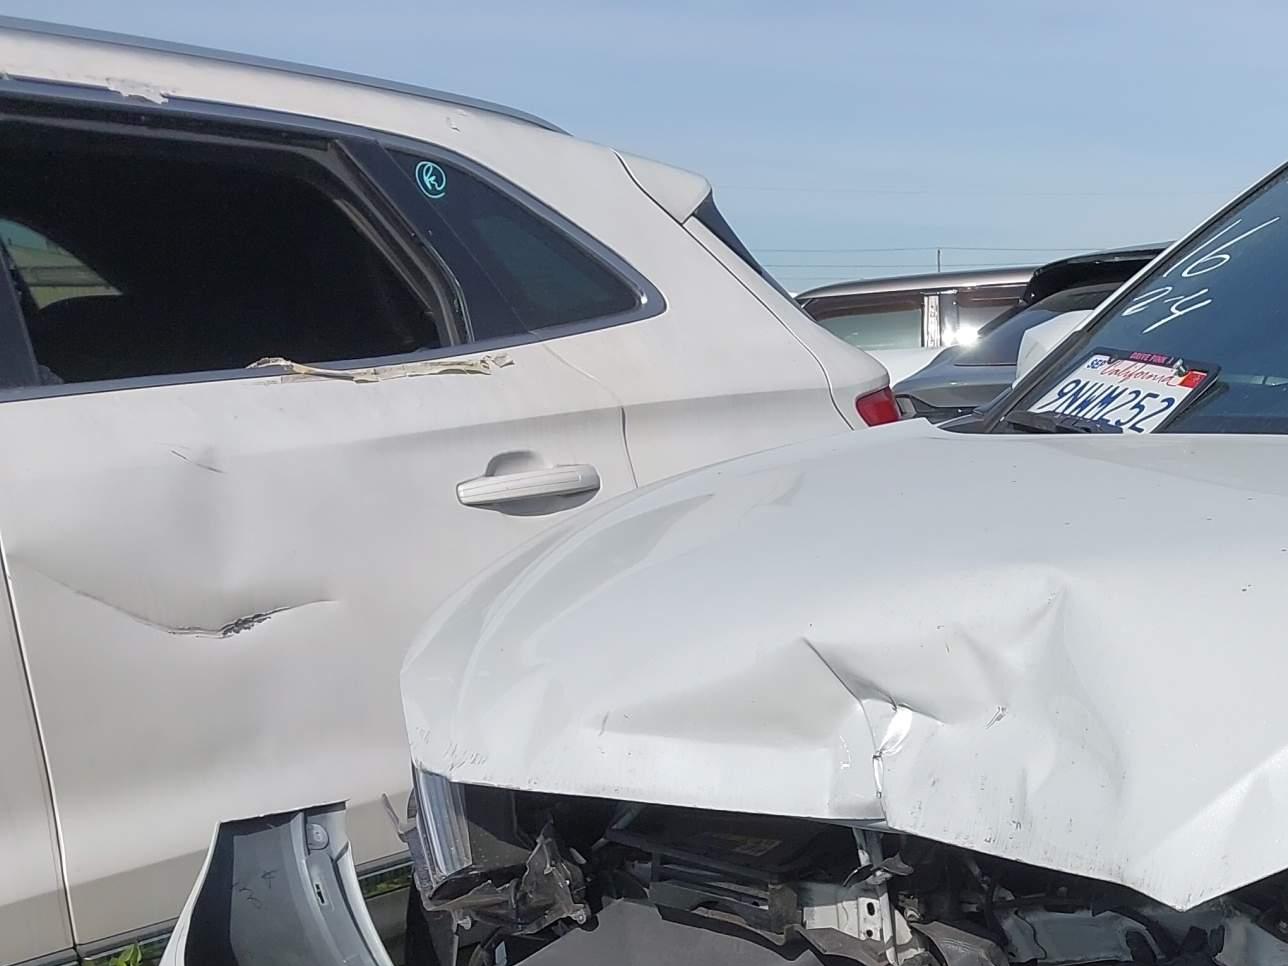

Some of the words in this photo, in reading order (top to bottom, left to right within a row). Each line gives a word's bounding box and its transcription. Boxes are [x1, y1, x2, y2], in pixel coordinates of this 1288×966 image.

[1163, 216, 1280, 277] 16
[1100, 360, 1178, 387] California
[1036, 379, 1176, 434] 9NWM252
